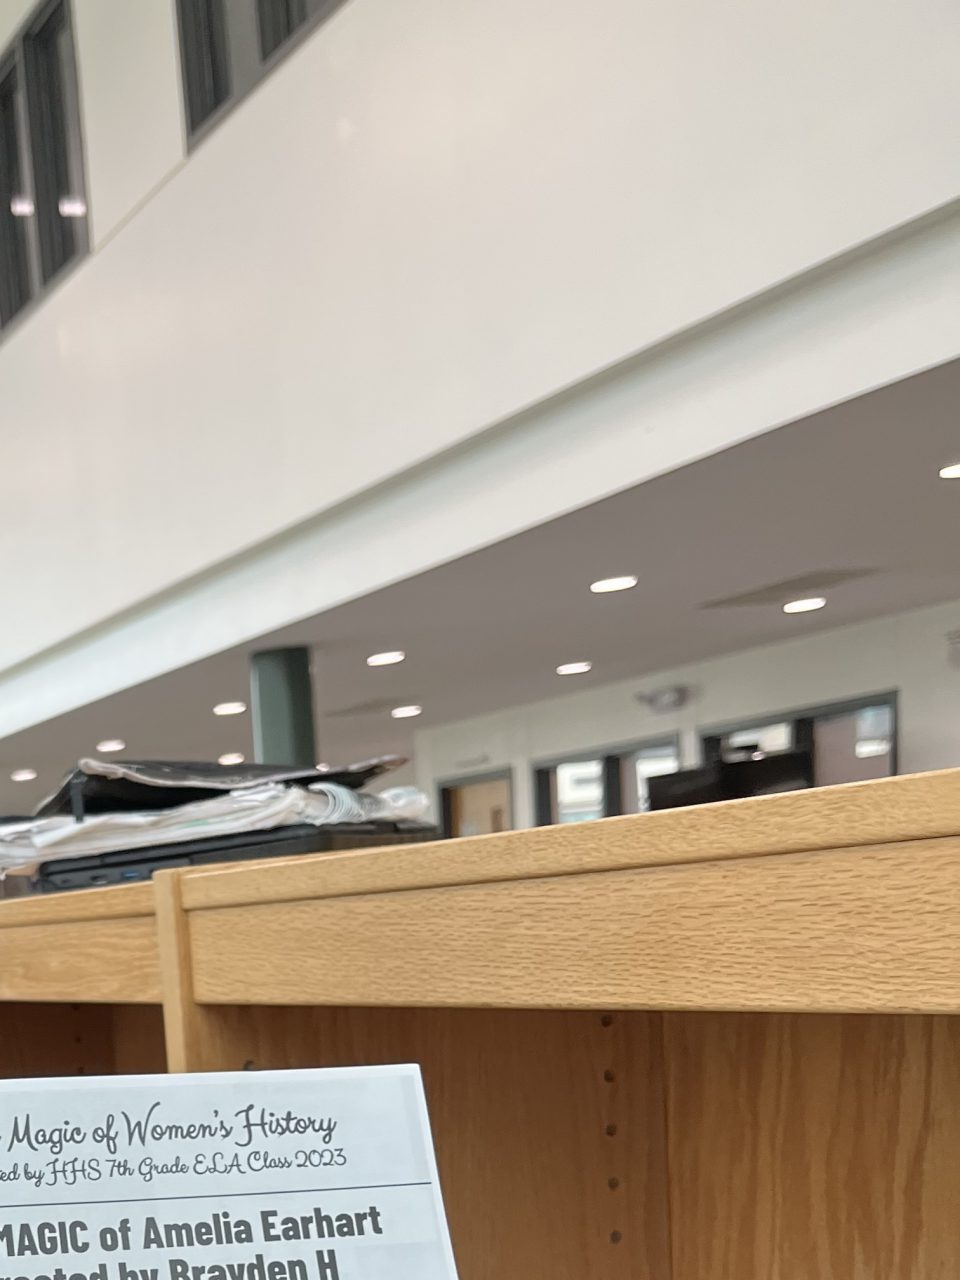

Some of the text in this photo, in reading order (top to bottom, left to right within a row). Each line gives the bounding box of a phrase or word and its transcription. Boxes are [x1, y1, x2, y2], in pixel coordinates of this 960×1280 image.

[7, 1114, 87, 1155] Magic
[92, 1114, 119, 1155] of
[234, 1103, 337, 1148] History
[23, 1162, 45, 1186] by
[105, 1159, 135, 1177] 7th
[138, 1156, 189, 1182] Grade
[193, 1152, 246, 1175] ELA
[247, 1151, 293, 1172] Class
[295, 1148, 347, 1168] 2023
[99, 1218, 131, 1252] of
[143, 1211, 254, 1249] Amelia
[260, 1206, 383, 1242] Earhart
